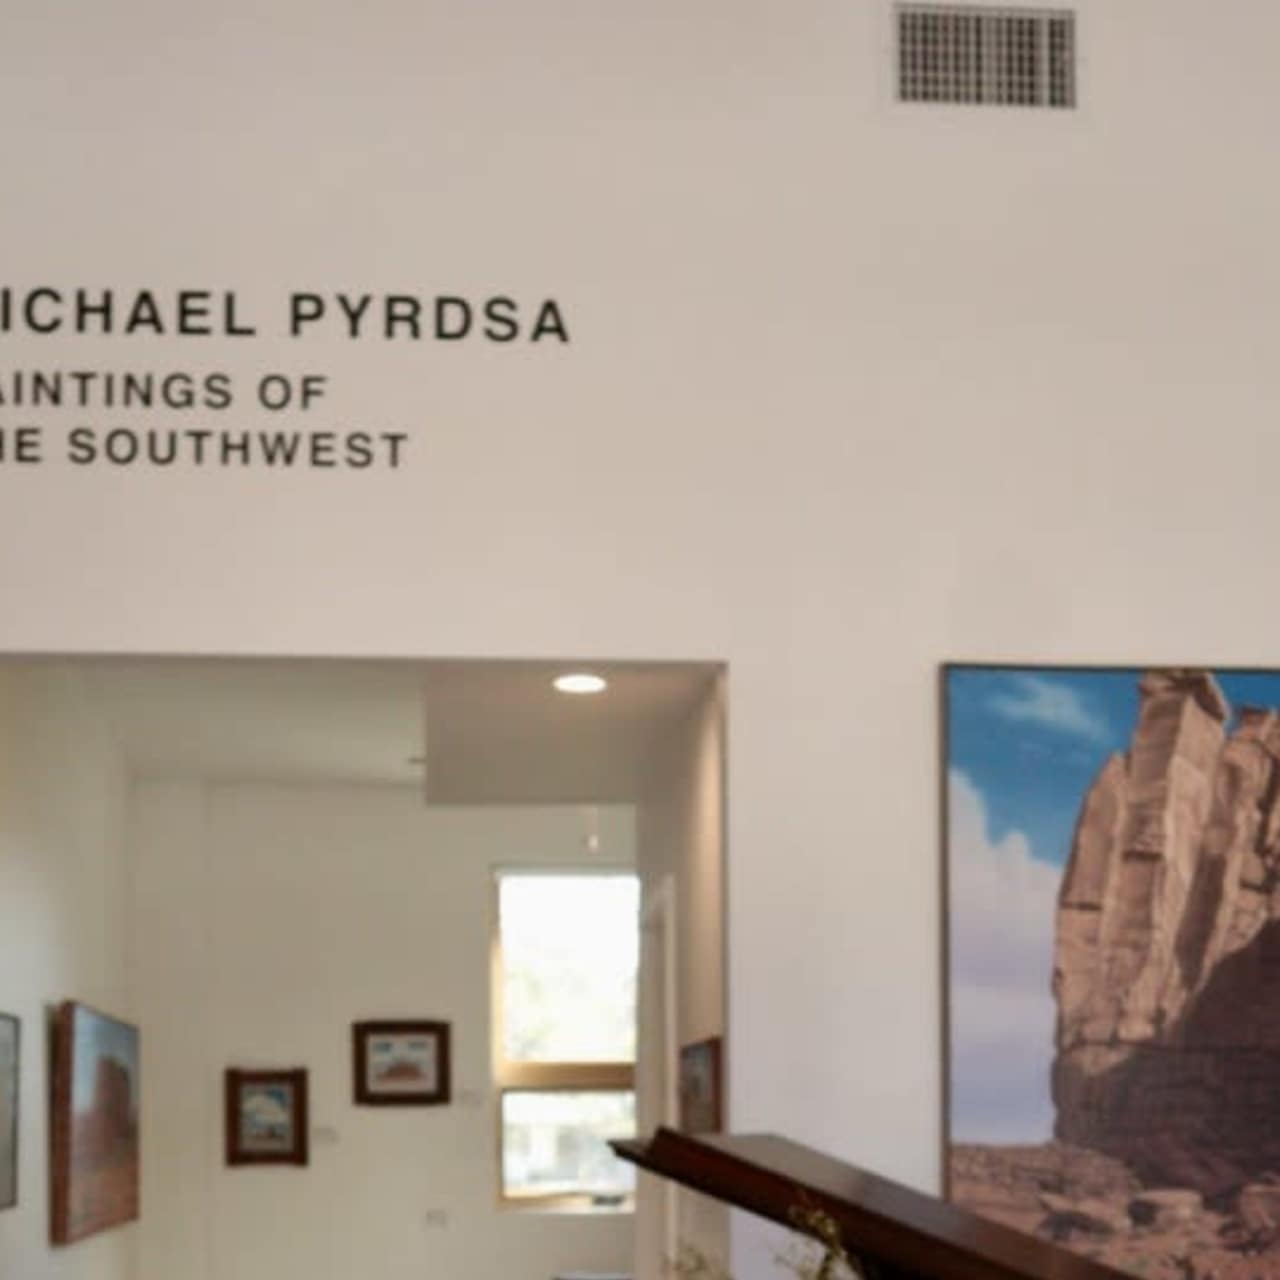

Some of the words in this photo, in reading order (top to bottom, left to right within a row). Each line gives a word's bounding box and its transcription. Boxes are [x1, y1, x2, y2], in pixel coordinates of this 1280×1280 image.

[290, 292, 569, 343] PYRDSA
[258, 374, 325, 411] OF
[68, 427, 407, 469] SOUTHWEST
